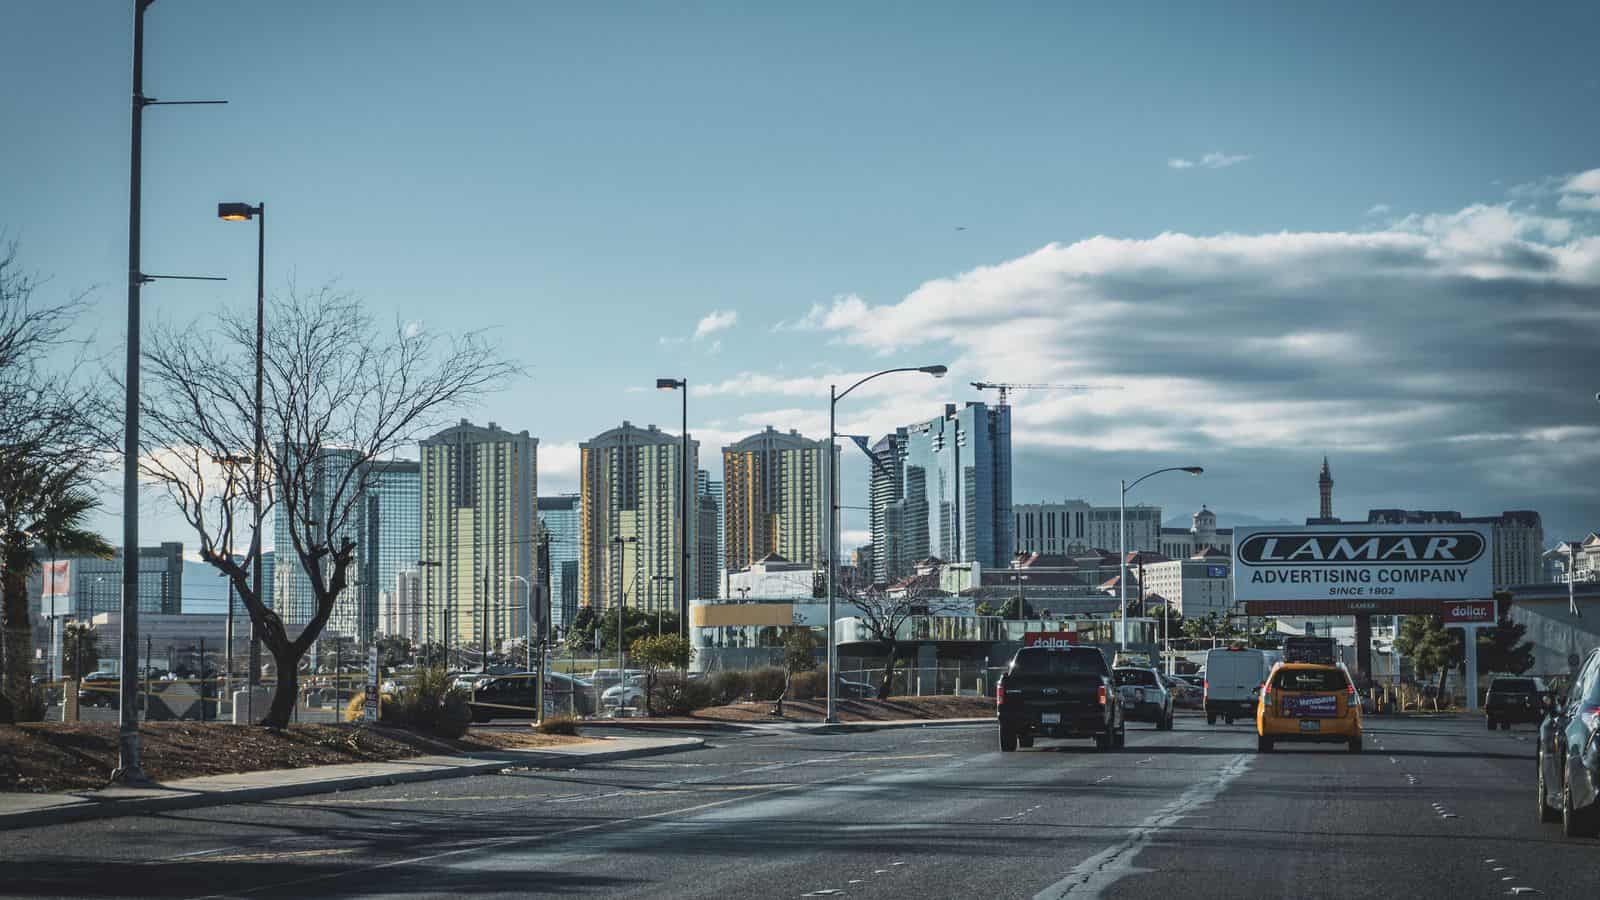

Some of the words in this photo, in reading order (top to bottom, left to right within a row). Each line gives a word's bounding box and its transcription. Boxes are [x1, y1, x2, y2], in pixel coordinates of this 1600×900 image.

[1260, 537, 1458, 560] LAMAR
[1251, 568, 1371, 584] ADVERTISING
[1377, 567, 1469, 583] COMPANY
[1328, 587, 1364, 596] SINCE
